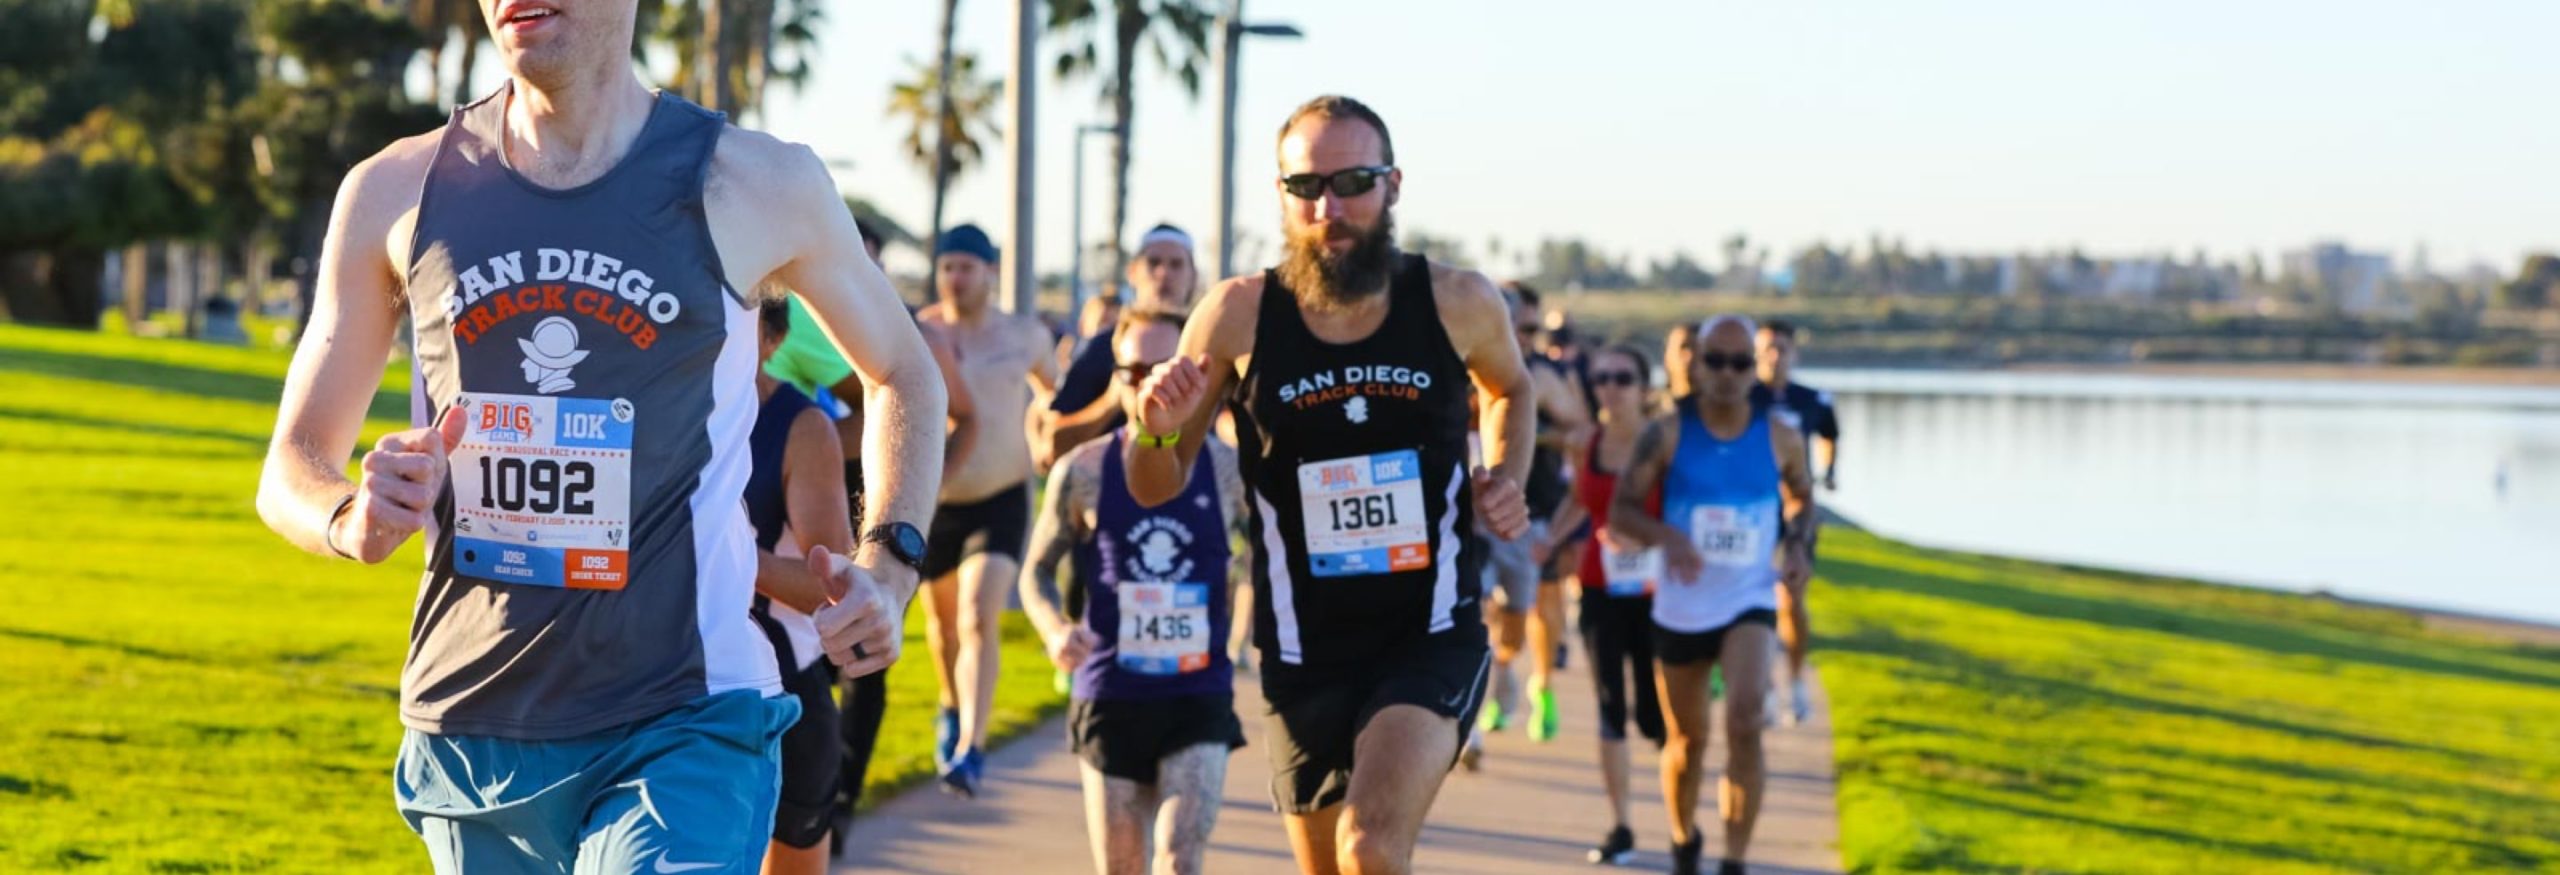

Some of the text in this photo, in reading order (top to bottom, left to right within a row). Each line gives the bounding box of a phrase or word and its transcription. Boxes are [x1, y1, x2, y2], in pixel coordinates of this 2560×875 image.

[439, 247, 681, 324] SAN DIEGO
[454, 284, 658, 350] TRACK CLUB
[1278, 365, 1432, 402] SAN DIEGO
[1293, 384, 1420, 410] TRACK CLUB
[480, 402, 533, 432] BIG
[562, 412, 608, 440] 10K
[479, 455, 595, 515] 1092
[1373, 459, 1404, 482] 10K
[1329, 492, 1398, 531] 1361
[503, 549, 527, 565] 1092
[581, 555, 609, 570] 1092
[1133, 614, 1193, 641] 1436
